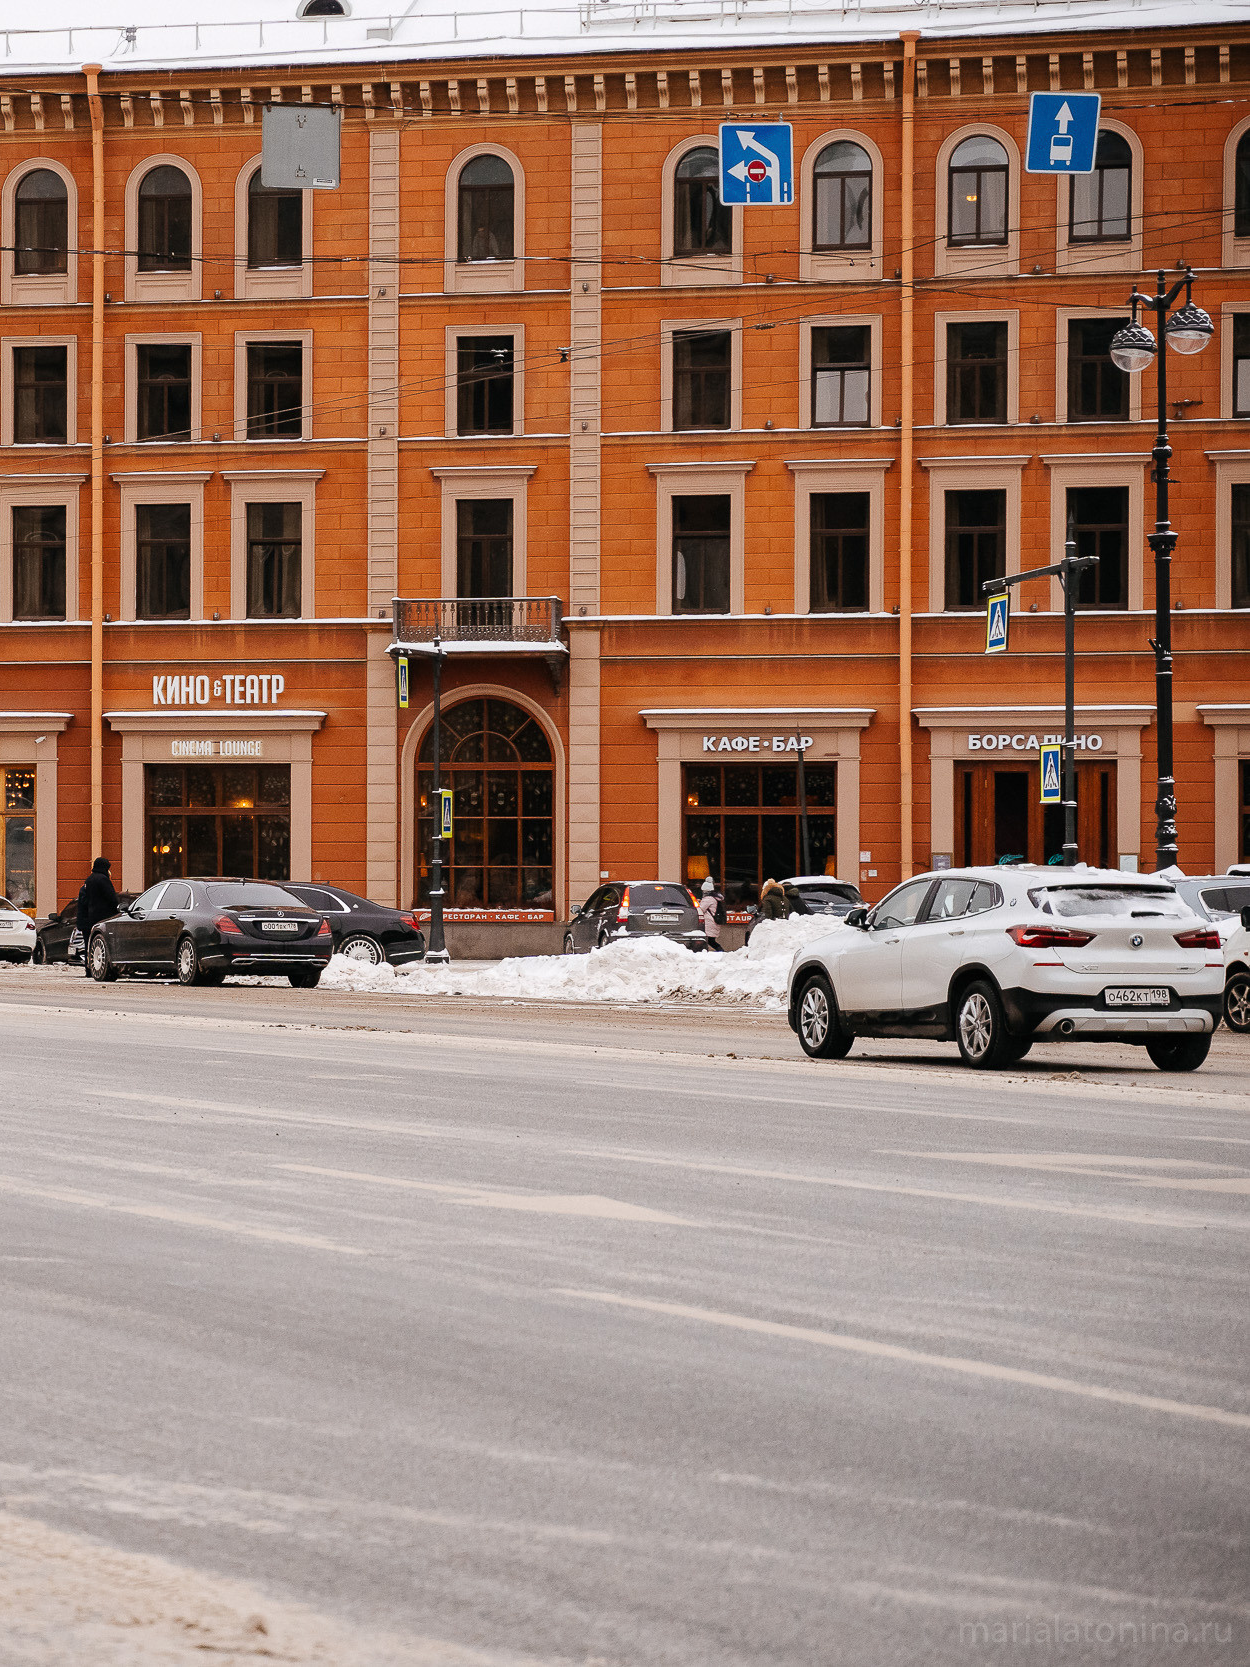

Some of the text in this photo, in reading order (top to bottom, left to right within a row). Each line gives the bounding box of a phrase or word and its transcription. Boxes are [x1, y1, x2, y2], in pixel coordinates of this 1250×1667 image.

[152, 675, 210, 705] КИНО
[222, 674, 285, 704] ТЕАТР
[171, 740, 262, 756] CINEMA LOUNGE
[1151, 990, 1167, 998] 198
